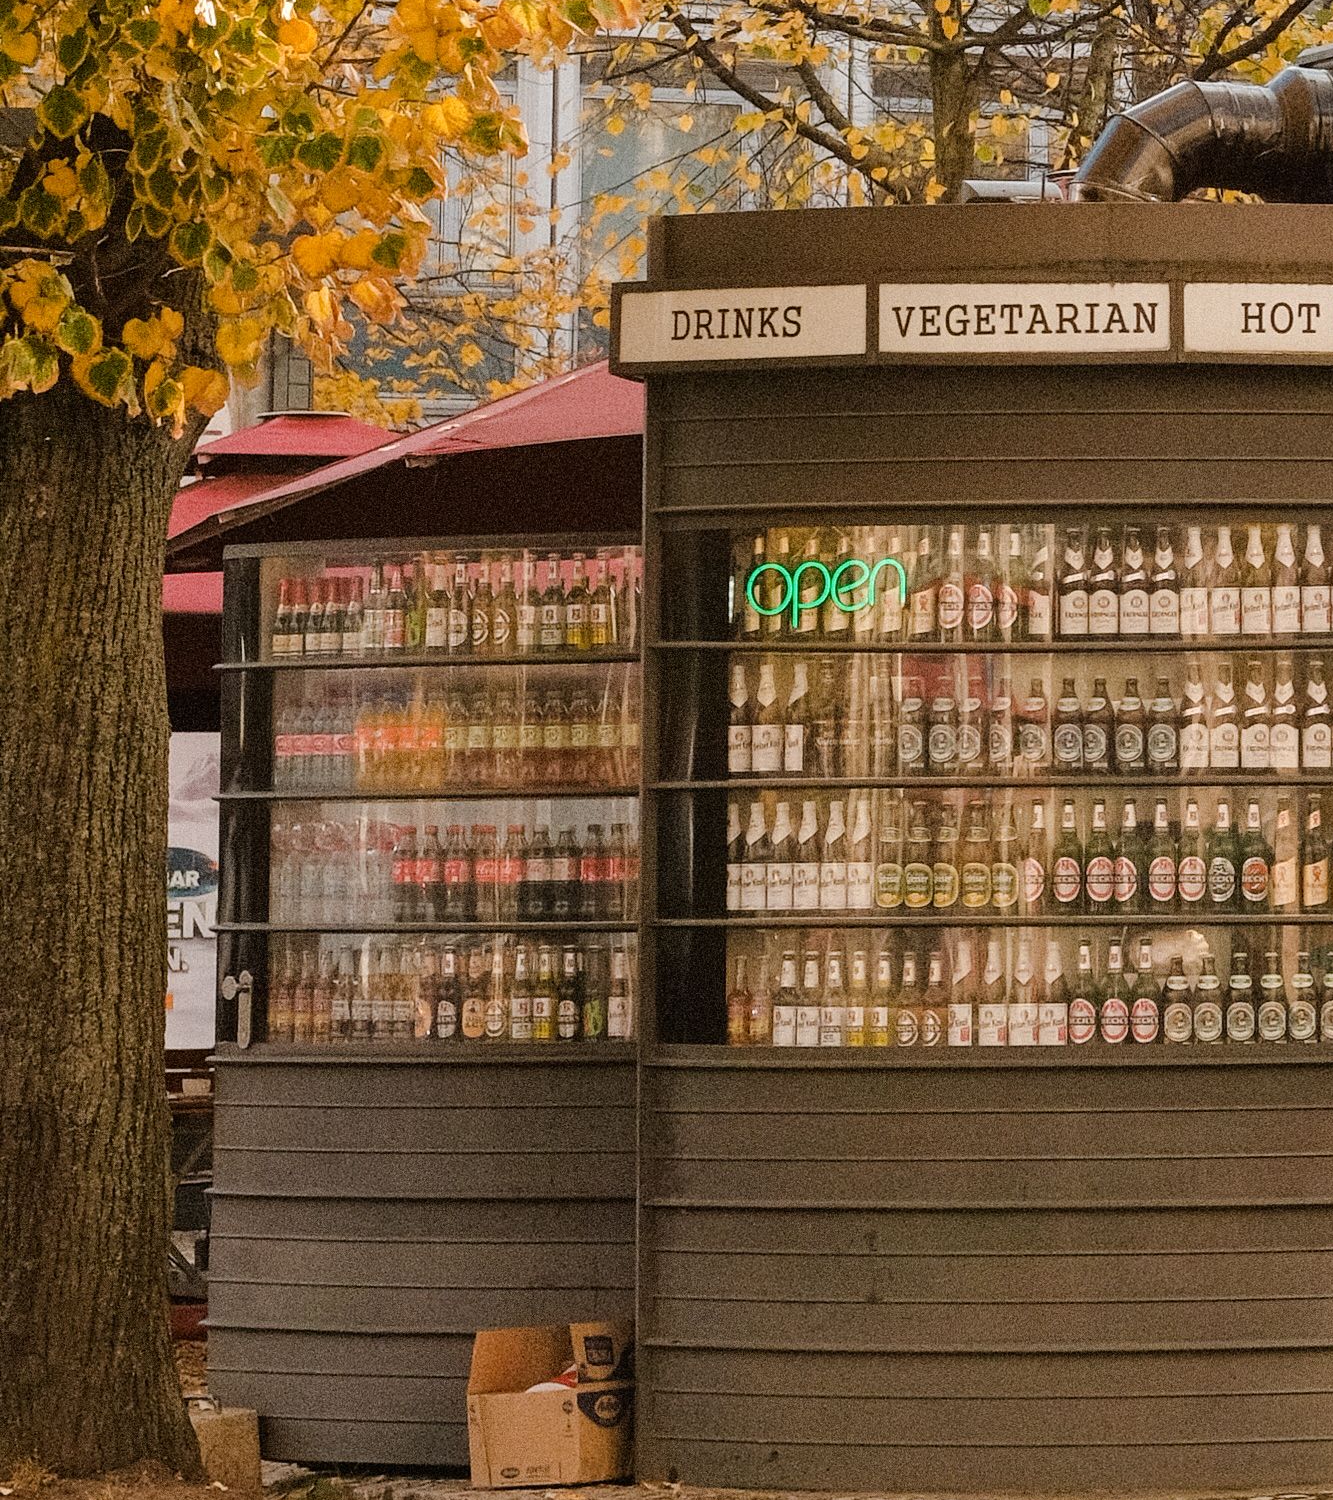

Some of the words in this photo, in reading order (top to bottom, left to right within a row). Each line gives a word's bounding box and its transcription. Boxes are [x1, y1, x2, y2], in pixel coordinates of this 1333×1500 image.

[670, 306, 803, 342] DRINKS
[892, 302, 1159, 339] VEGETARIAN
[1240, 302, 1322, 335] HOT
[746, 557, 907, 629] open
[167, 869, 200, 888] AR
